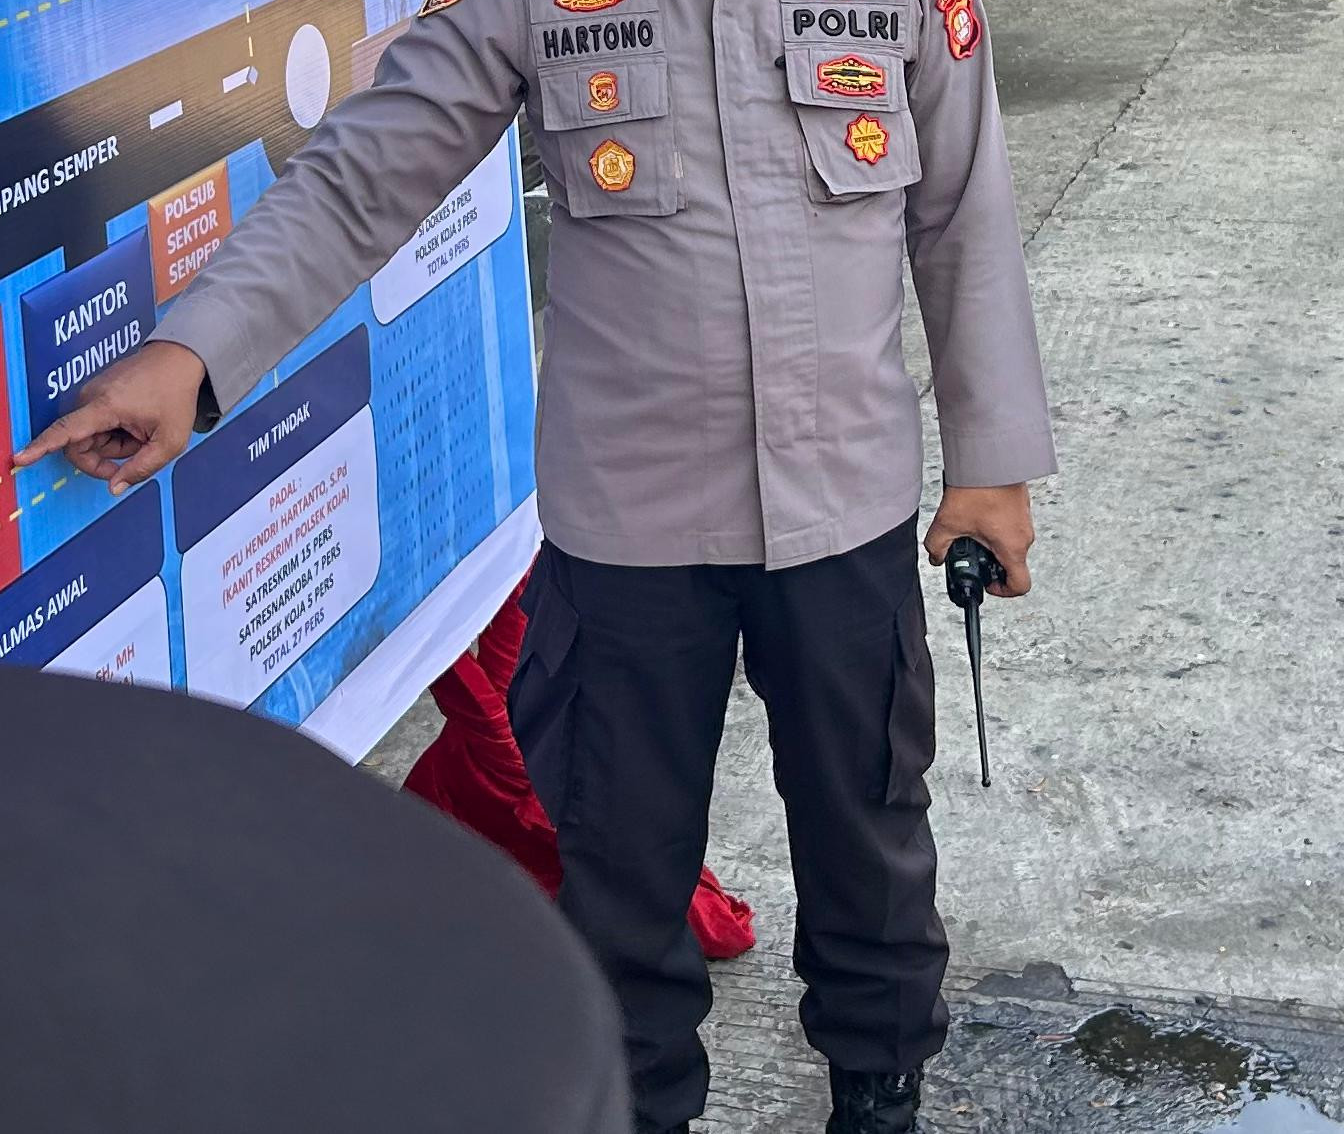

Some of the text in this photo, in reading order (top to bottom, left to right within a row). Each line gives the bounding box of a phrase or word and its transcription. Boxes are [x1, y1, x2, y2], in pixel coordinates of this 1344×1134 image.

[543, 18, 654, 59] HARTONO
[792, 8, 899, 41] POLRI
[53, 136, 120, 191] SEMPER
[164, 179, 216, 226] POLSUB
[456, 189, 473, 210] PERS
[167, 209, 218, 255] SEKTOR
[415, 235, 440, 263] POLSEK
[440, 224, 457, 243] KOJA
[462, 207, 478, 229] PERS
[427, 252, 449, 277] TOTAL
[455, 235, 470, 257] PERS
[54, 281, 129, 347] KANTOR
[47, 319, 142, 400] SUDINHUB
[248, 401, 311, 462] TIM TINDAK
[222, 461, 347, 580] IPTU HENDRI HARTANTO, S.Pd
[269, 479, 297, 512] PADAL
[222, 484, 350, 607] (KANIT RESKRIM POLSEK KOJA)
[245, 524, 333, 613] SATRESKRIM 15 PERS
[47, 573, 88, 620] AWAL
[239, 568, 313, 645] SATRESNARKOBA
[321, 542, 341, 571] PERS
[250, 617, 283, 662] POLSEK
[284, 600, 306, 630] KOJA
[314, 573, 334, 602] PERS
[116, 642, 135, 670] MH
[262, 607, 325, 675] TOTAL 27 PERS
